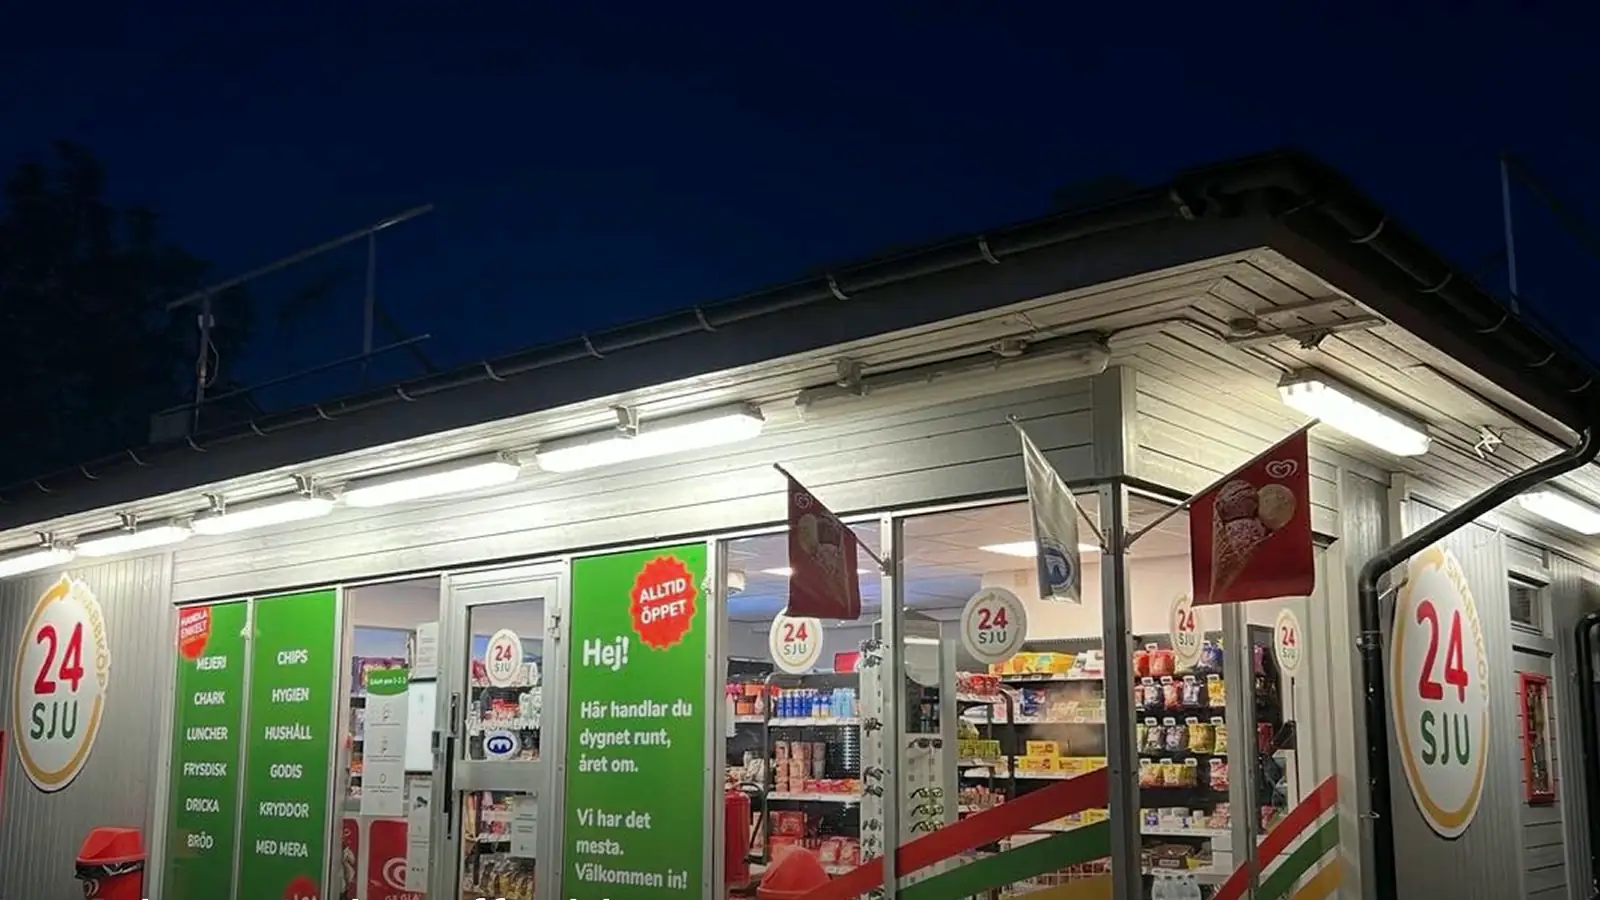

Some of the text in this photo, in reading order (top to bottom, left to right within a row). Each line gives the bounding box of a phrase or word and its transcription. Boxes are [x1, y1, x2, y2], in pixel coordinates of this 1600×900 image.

[639, 577, 686, 604] ALLTID
[641, 599, 688, 624] ÖPPET
[978, 606, 1009, 631] 24
[1177, 609, 1195, 632] 24
[783, 622, 808, 643] 24
[978, 631, 1007, 645] SJU
[1179, 632, 1195, 646] SJU
[1282, 627, 1295, 647] 24
[34, 622, 84, 695] 24
[277, 649, 309, 665] CHIPS
[495, 645, 513, 661] 24
[583, 635, 629, 671] Hej!
[783, 643, 807, 656] SJU
[1416, 599, 1469, 703] 24
[196, 656, 227, 670] MEJERI
[494, 662, 511, 673] SJU
[194, 691, 226, 706] CHARK
[272, 687, 310, 703] HYGIEN
[580, 698, 693, 719] Här handlar du
[30, 700, 78, 740] SJU
[187, 726, 229, 741] LUNCHER
[265, 723, 313, 740] HUSHÅLL
[579, 728, 672, 749] dygnet runt,
[1420, 710, 1470, 766] SJU
[183, 762, 228, 777] FRYSDISK
[270, 764, 303, 779] GODIS
[578, 753, 639, 773] året om.
[186, 798, 220, 813] DRICKA
[259, 802, 310, 818] KRYDDOR
[576, 808, 652, 829] Vi har det
[187, 831, 214, 849] BRÖD
[256, 839, 309, 858] MED MERA
[576, 838, 625, 856] mesta.
[575, 862, 688, 890] Välkommen in!
